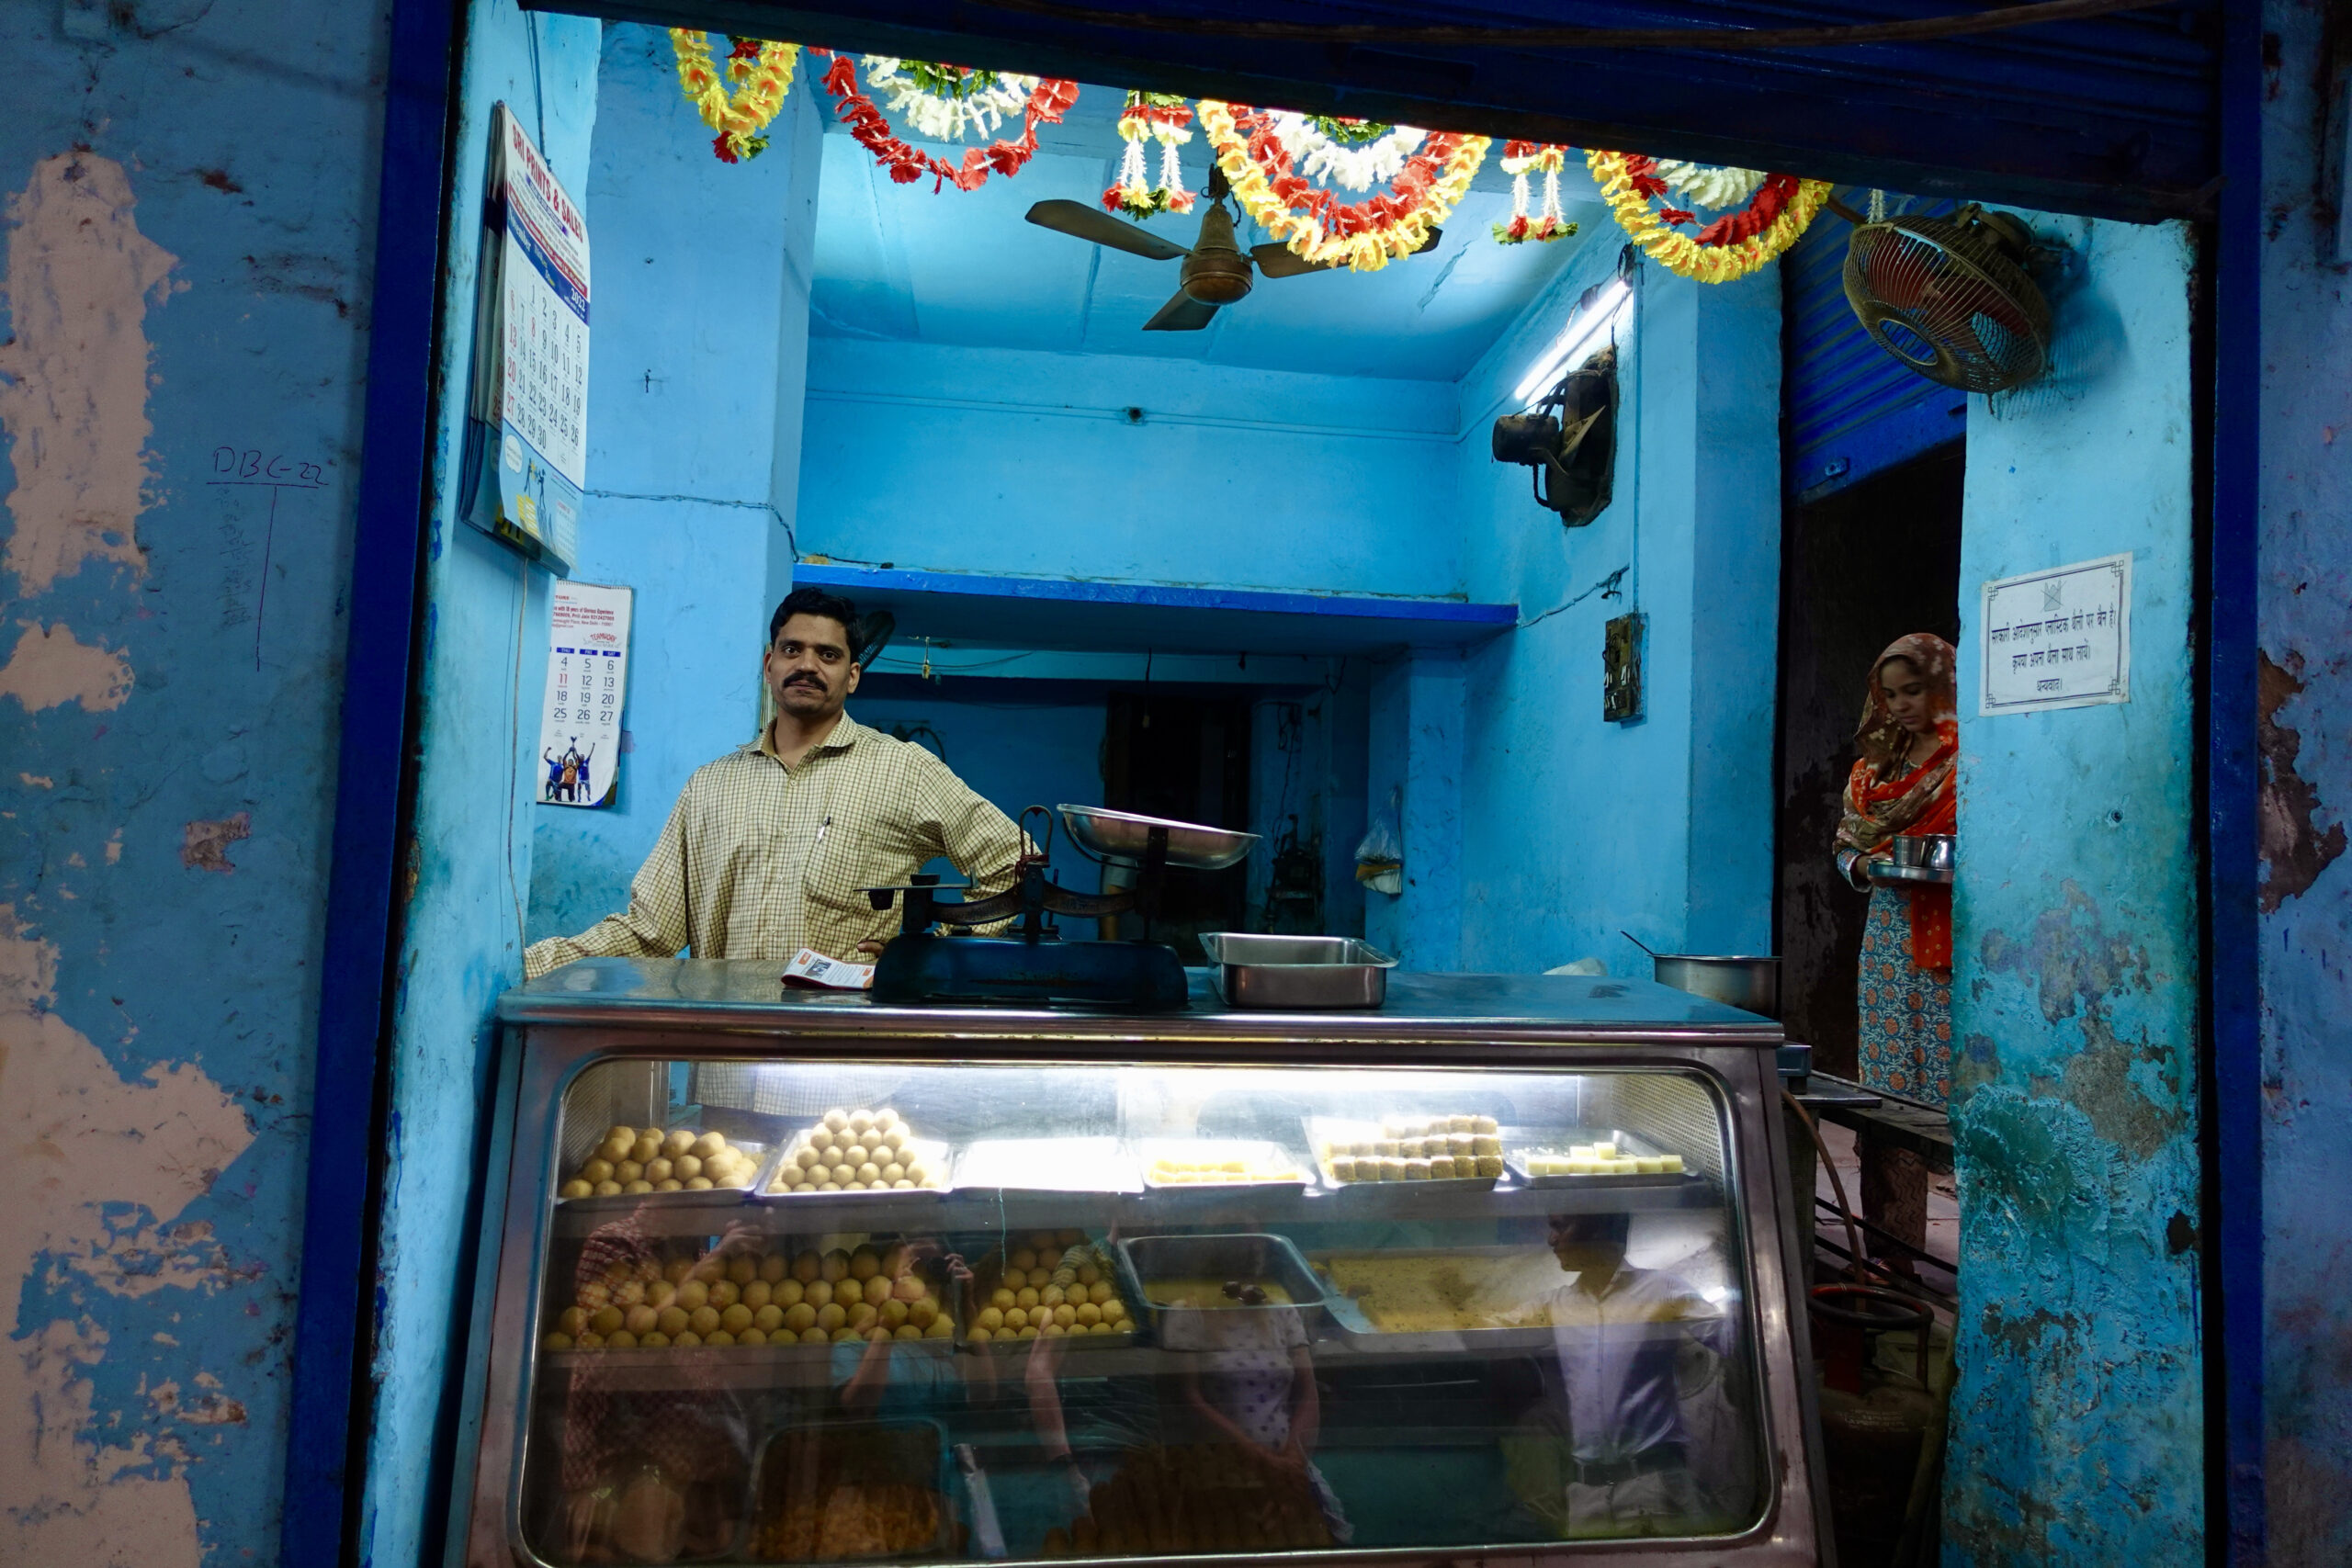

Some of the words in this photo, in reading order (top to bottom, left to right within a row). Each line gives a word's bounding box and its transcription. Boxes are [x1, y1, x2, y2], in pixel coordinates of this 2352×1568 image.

[513, 124, 525, 162] SRI
[526, 146, 551, 202] PRINTS
[553, 188, 560, 213] &
[561, 198, 583, 243] SALES
[571, 287, 586, 311] 2022
[510, 289, 515, 310] 6
[531, 316, 536, 337] 8
[542, 329, 548, 349] 9
[550, 341, 559, 364] 10
[562, 353, 570, 375] 11
[575, 364, 582, 385] 12
[542, 297, 547, 318] 2
[552, 310, 558, 330] 3
[564, 323, 570, 343] 4
[576, 333, 581, 353] 5
[510, 322, 517, 347] 13
[520, 336, 526, 361] 14
[529, 348, 537, 372] 15
[539, 360, 548, 384] 16
[550, 373, 558, 394] 17
[562, 383, 570, 406] 18
[573, 395, 581, 416] 19
[507, 355, 516, 382] 20
[518, 368, 526, 394] 21
[529, 380, 537, 405] 22
[538, 391, 547, 417] 23
[548, 403, 558, 428] 24
[560, 413, 568, 437] 25
[571, 423, 579, 446] 26
[507, 391, 515, 416] 27
[517, 402, 525, 428] 28
[527, 414, 536, 438] 29
[537, 424, 547, 449] 30
[1992, 621, 2010, 645] सरकारी
[2012, 618, 2043, 644] आदेशानुसार
[2045, 613, 2069, 636] प्लास्टिक
[2072, 608, 2084, 632] थैली
[2086, 613, 2095, 629] पर
[560, 657, 568, 667] 4
[584, 658, 592, 669] 5
[607, 660, 615, 671] 6
[2012, 653, 2028, 675] कृपया
[2030, 651, 2045, 668] अपना
[2047, 642, 2060, 665] थैला
[2062, 647, 2074, 663] साथ
[557, 690, 568, 702] 18
[580, 692, 591, 704] 19
[602, 694, 615, 705] 20
[560, 673, 568, 684] 11
[582, 675, 593, 686] 12
[604, 677, 615, 688] 13
[2036, 678, 2063, 692] धन्यवाद।
[553, 707, 567, 718] 25
[577, 709, 591, 720] 26
[600, 711, 614, 722] 27
